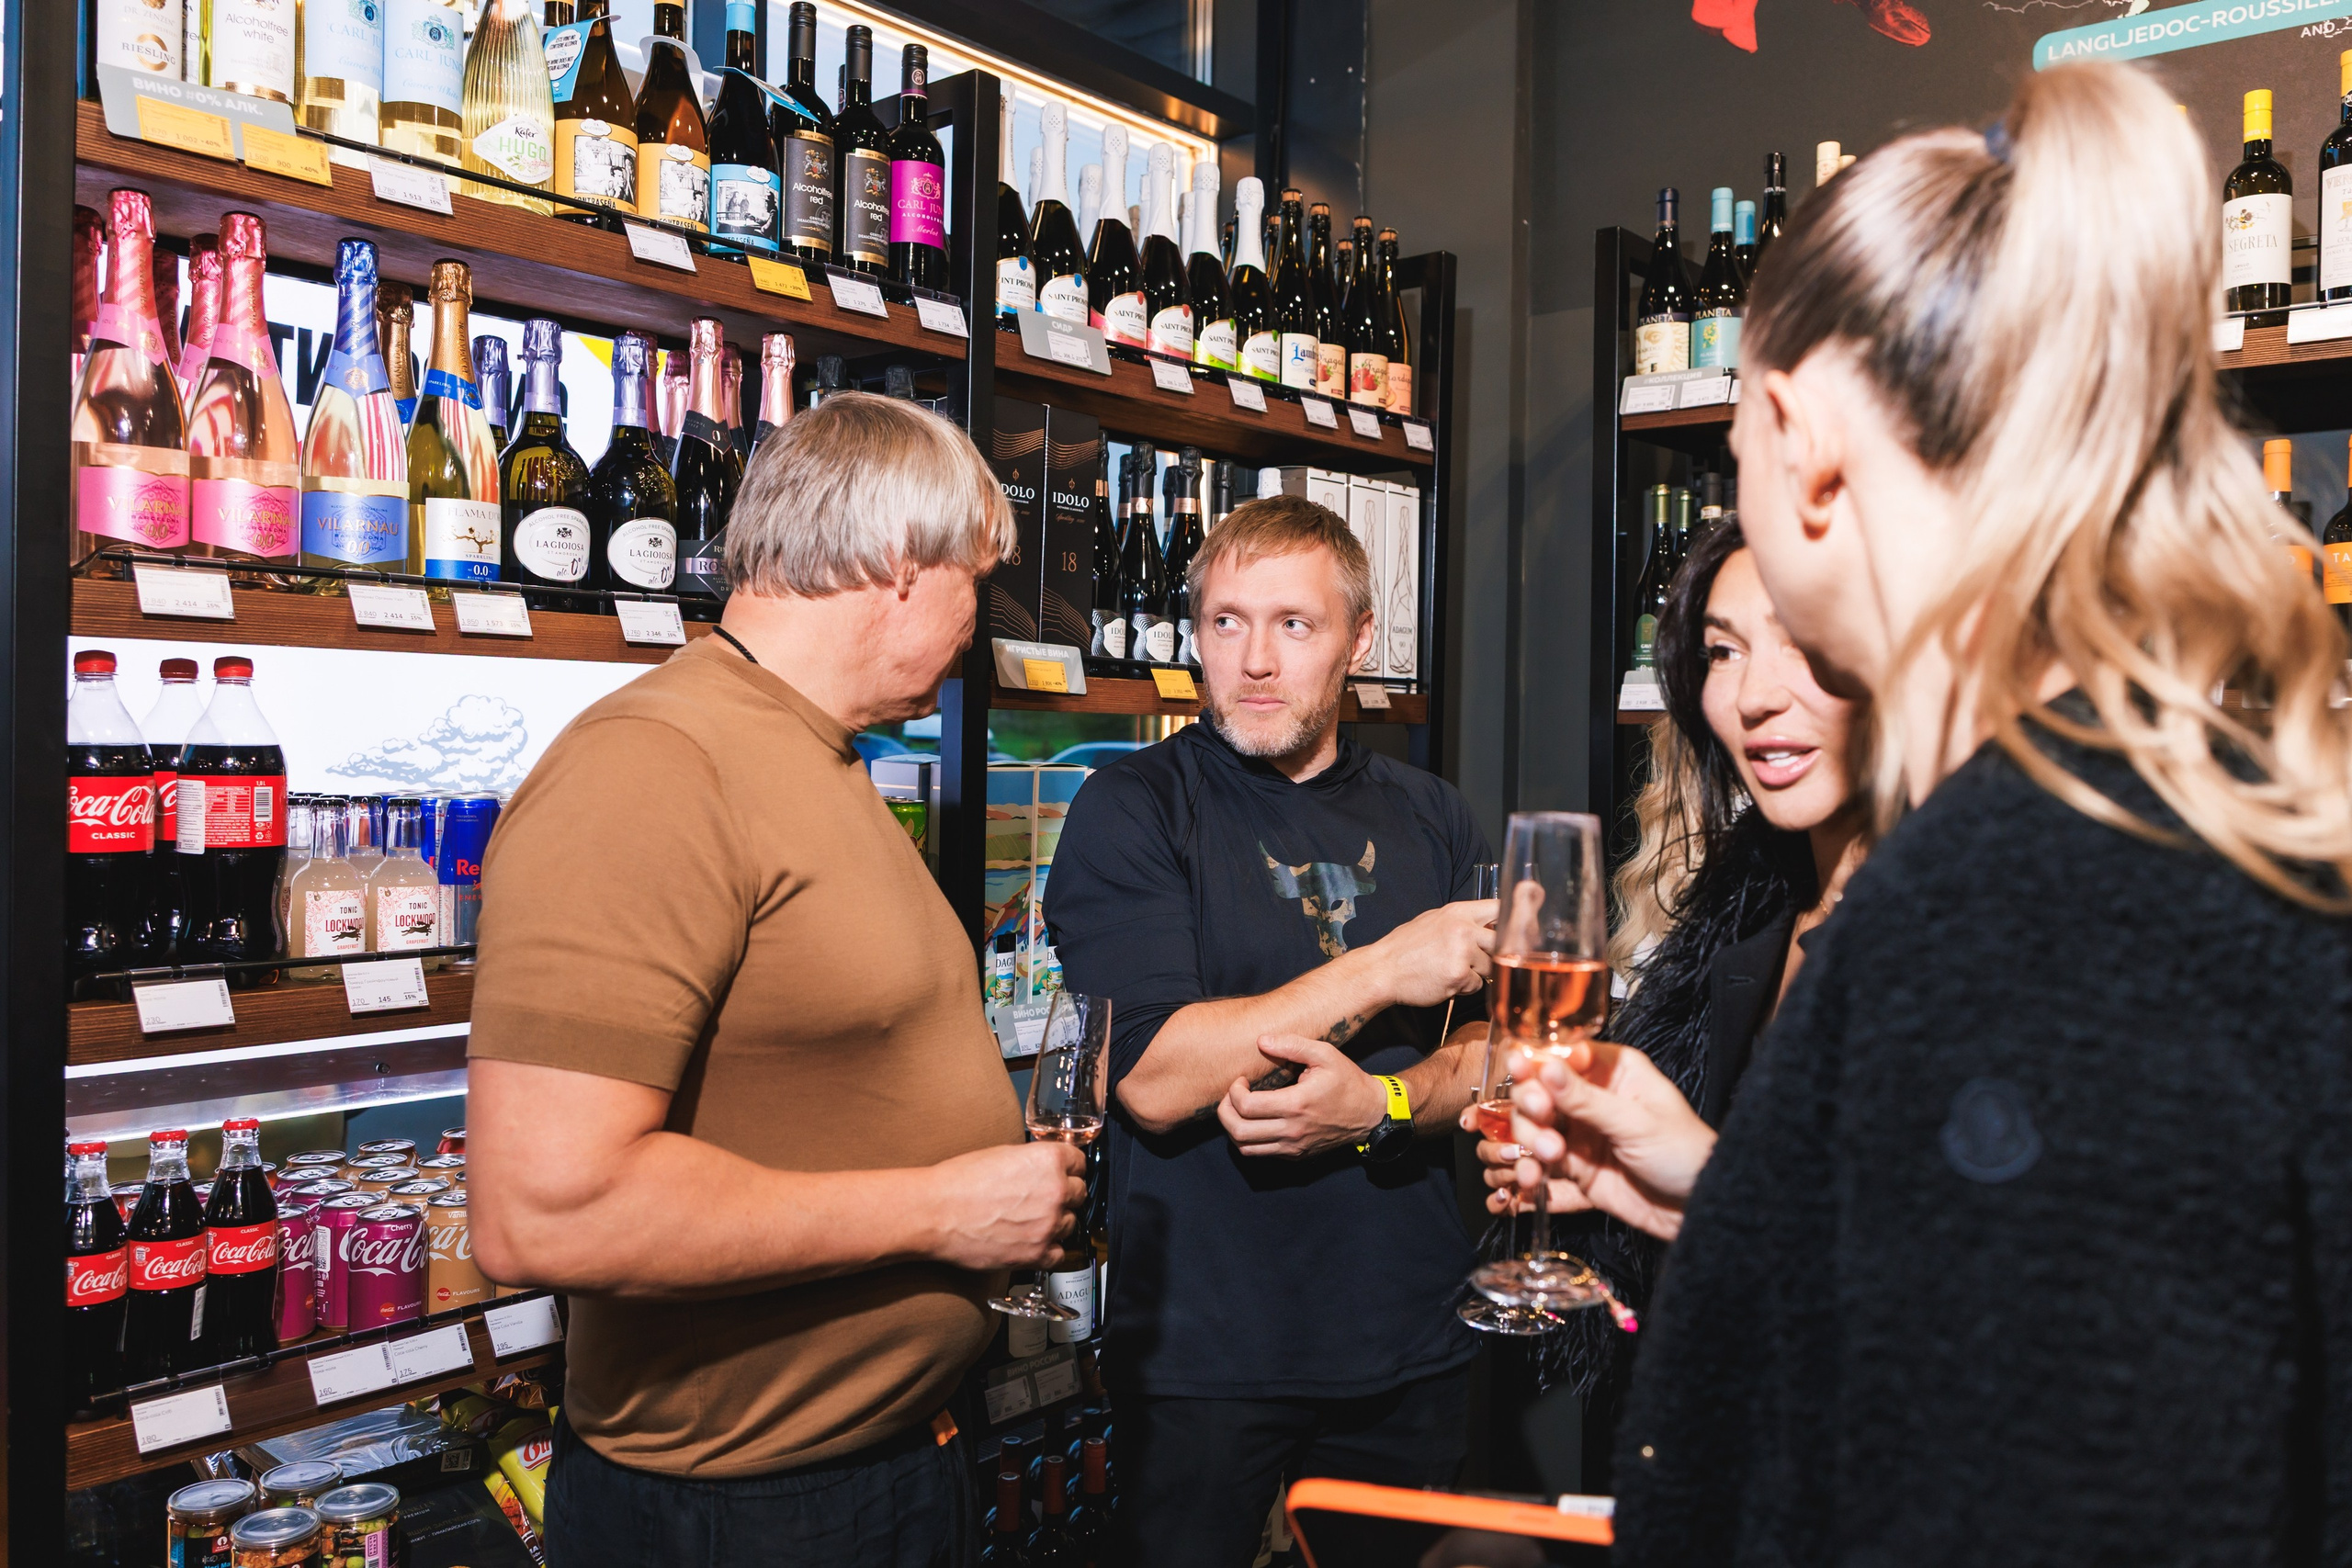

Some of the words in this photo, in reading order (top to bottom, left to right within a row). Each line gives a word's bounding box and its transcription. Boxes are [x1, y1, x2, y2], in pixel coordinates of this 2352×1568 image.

[226, 13, 288, 38] Alcoholfree
[329, 23, 368, 40] CARL
[2301, 22, 2335, 38] AND
[243, 28, 275, 44] white
[121, 42, 176, 66] RIESLING
[395, 48, 433, 62] CARL
[131, 77, 182, 98] ВИНО
[224, 98, 264, 116] АЛК.
[499, 136, 547, 161] HUGO
[2325, 174, 2352, 189] VEN
[793, 182, 832, 200] Alcoholfree
[809, 195, 823, 205] red
[898, 199, 925, 210] CARL
[930, 203, 944, 215] JUN
[854, 199, 889, 216] Alcoholfree
[870, 211, 883, 221] red
[902, 212, 944, 225] ALCOHOLFRE
[911, 225, 939, 237] Merlot
[2228, 234, 2278, 253] SEGRETA
[1640, 313, 1674, 325] PLANETA
[1695, 308, 1733, 320] PLANETA
[1051, 321, 1073, 333] СИДР
[1001, 483, 1035, 500] DOLO
[1053, 491, 1090, 508] IDOLO
[218, 508, 296, 528] VILARNAU
[447, 506, 485, 520] FLAMA
[528, 513, 555, 527] ALCOHOL
[317, 517, 399, 536] VILARNAU
[622, 525, 648, 537] ALCOHOL
[550, 541, 584, 551] GIOIOSA
[642, 550, 673, 559] GIOIOSA
[1061, 551, 1077, 571] 18
[473, 564, 489, 576] 0.0
[699, 560, 724, 571] ROS
[1111, 627, 1125, 636] IDO
[1153, 631, 1174, 639] IDOL
[1005, 644, 1046, 657] ИГРИСТЫЕ
[1047, 649, 1069, 659] ВИНА
[92, 831, 135, 840] CLASSIC
[456, 859, 481, 875] Re
[325, 917, 365, 932] LOCKWOOD
[395, 913, 435, 927] LOCKWOOD
[1013, 1009, 1035, 1019] ВИНО
[448, 1211, 468, 1219] Vanil
[390, 1223, 413, 1232] Cherry
[212, 1235, 276, 1264] Coca-Cola
[348, 1221, 429, 1277] Coca-Co
[145, 1248, 206, 1280] Coca-Cola
[74, 1260, 128, 1296] Coca-Co
[453, 1288, 480, 1296] FLAVOURS
[1057, 1288, 1090, 1300] ADAGU
[397, 1300, 422, 1311] FLAVOURS
[496, 1342, 509, 1351] 195
[1007, 1364, 1028, 1377] ВИНО
[1030, 1352, 1059, 1368] РОССИИ
[400, 1368, 413, 1378] 175
[319, 1387, 333, 1397] 160
[141, 1434, 157, 1446] 180
